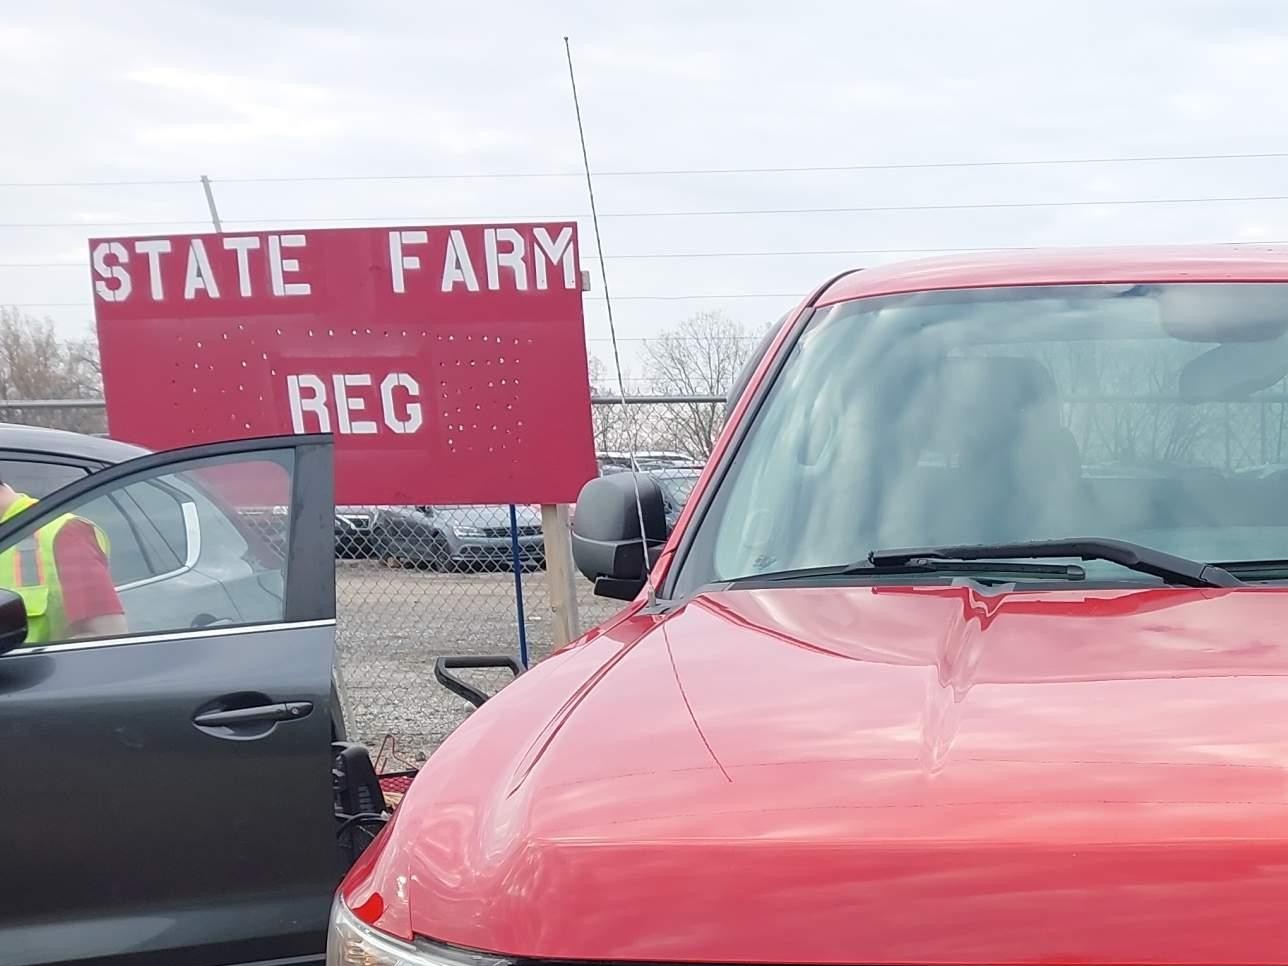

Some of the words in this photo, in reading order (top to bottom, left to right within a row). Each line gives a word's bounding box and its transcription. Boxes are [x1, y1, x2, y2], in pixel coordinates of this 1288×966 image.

[92, 235, 312, 302] STATE
[390, 227, 578, 294] FARM
[287, 372, 424, 434] REG
